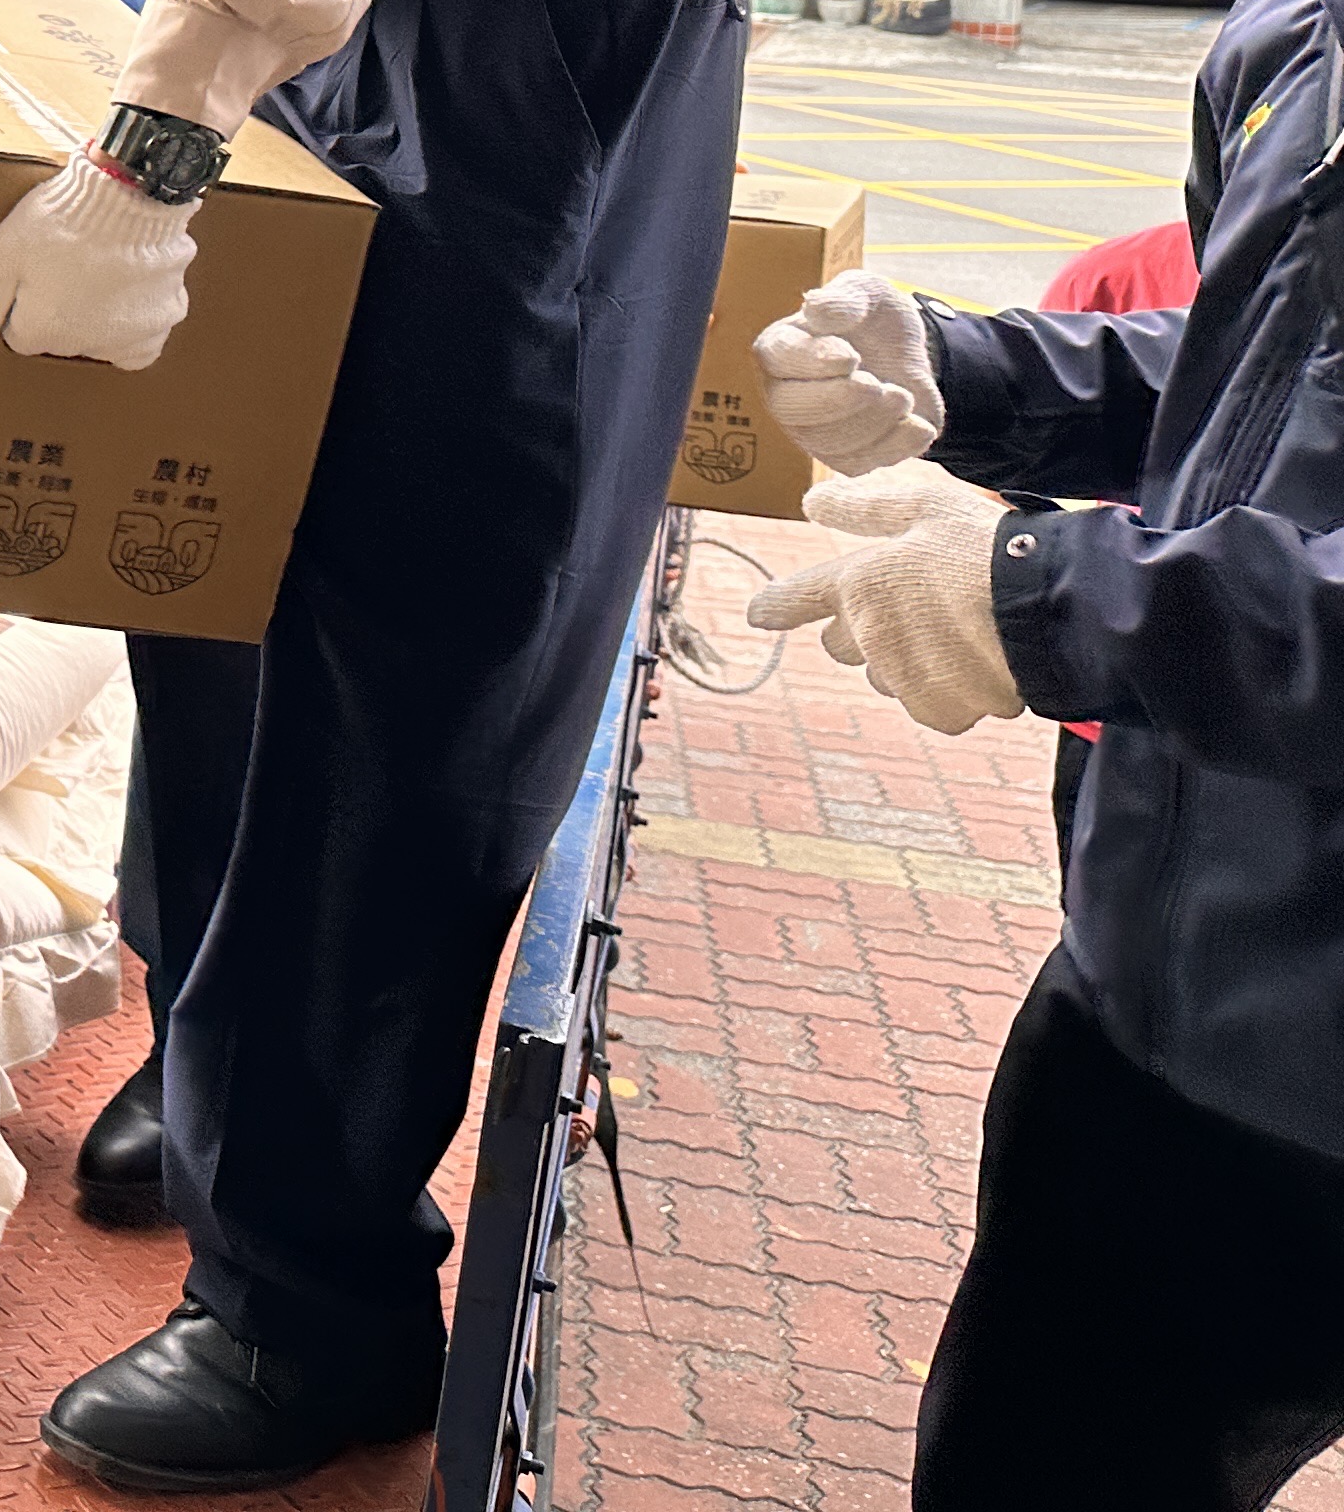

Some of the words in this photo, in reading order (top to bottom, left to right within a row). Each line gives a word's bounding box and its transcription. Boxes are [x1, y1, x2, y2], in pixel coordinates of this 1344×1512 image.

[703, 391, 741, 410] 農村
[6, 439, 65, 466] 農業
[153, 458, 211, 486] 農村
